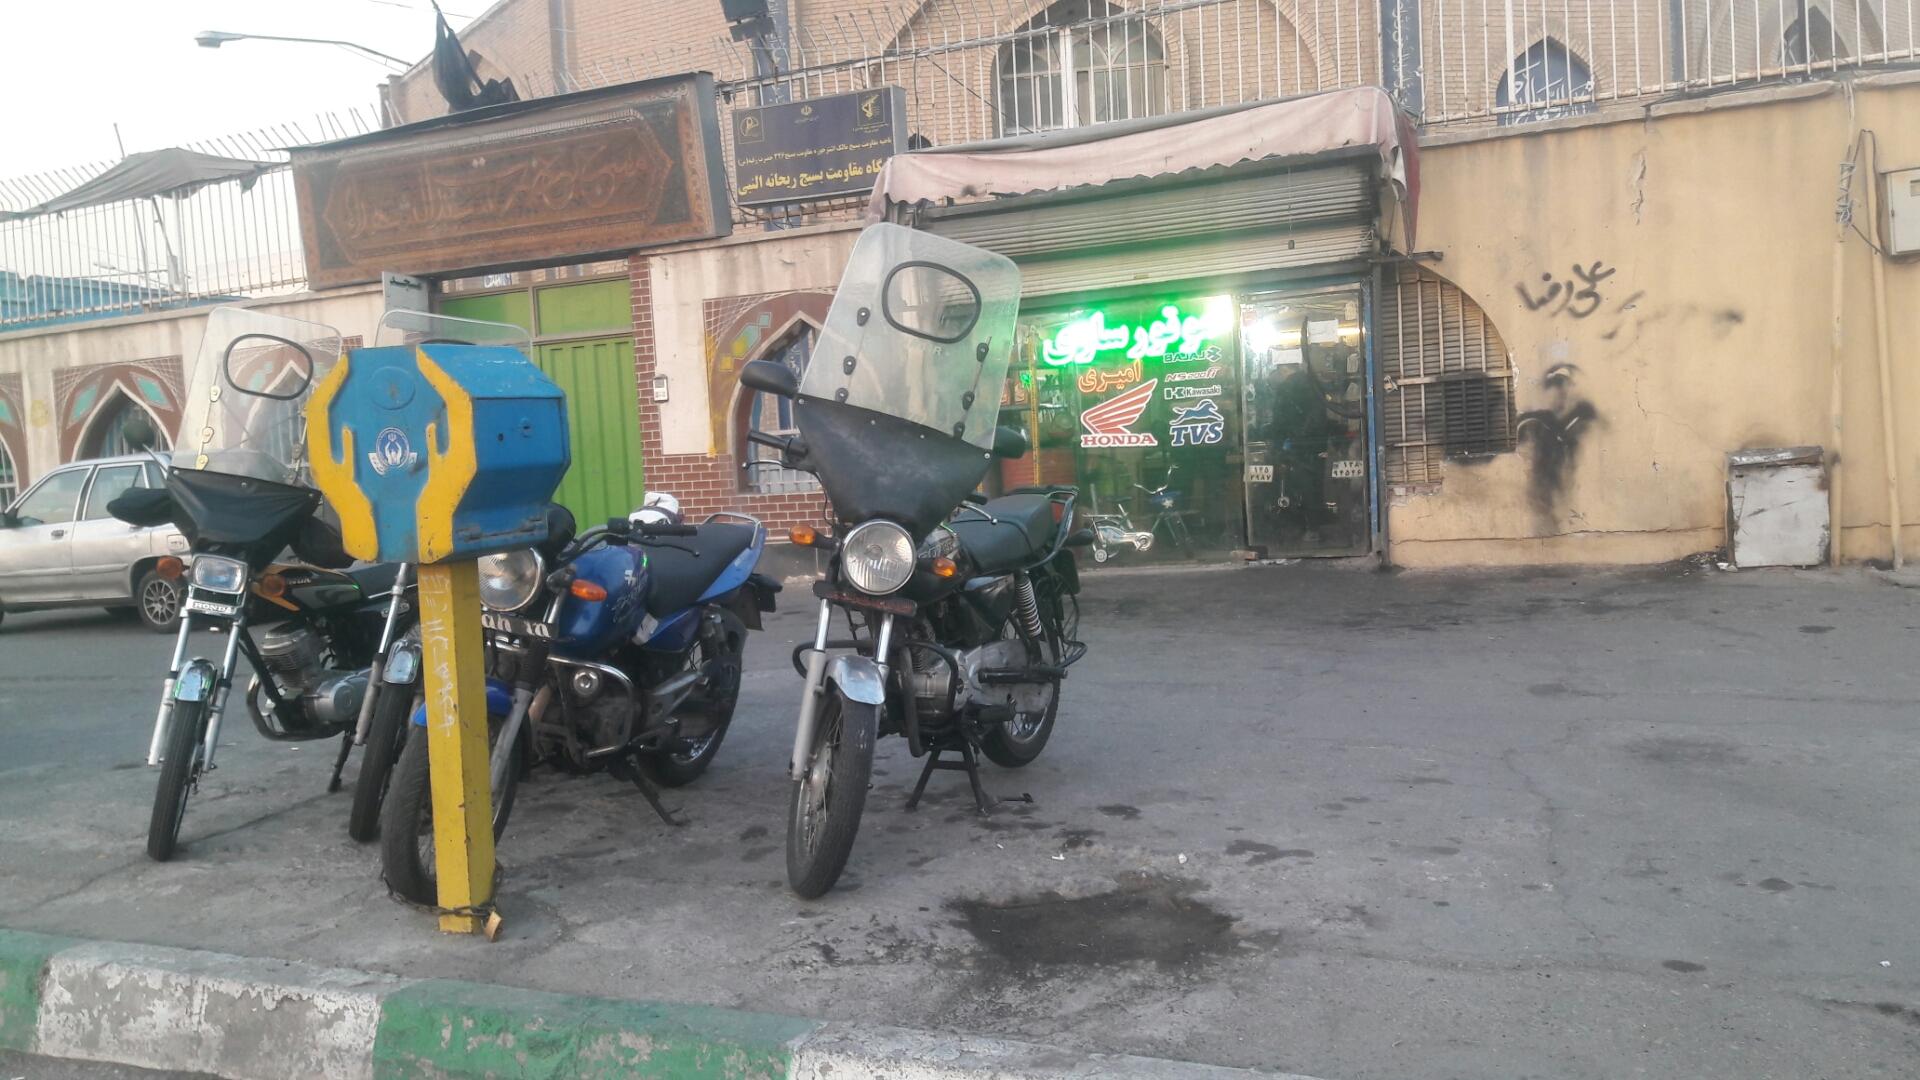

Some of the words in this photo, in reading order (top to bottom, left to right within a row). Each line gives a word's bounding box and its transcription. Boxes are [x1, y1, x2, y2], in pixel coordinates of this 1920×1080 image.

[765, 172, 797, 189] ریحانه
[799, 169, 824, 187] بسیج
[825, 162, 863, 183] مقاومت
[737, 174, 763, 196] النبی
[1163, 350, 1207, 364] BAJAJ
[1078, 358, 1142, 393] امیری
[1185, 384, 1222, 398] Kawasaki
[1081, 433, 1158, 448] HONDA
[1169, 421, 1224, 447] TVS
